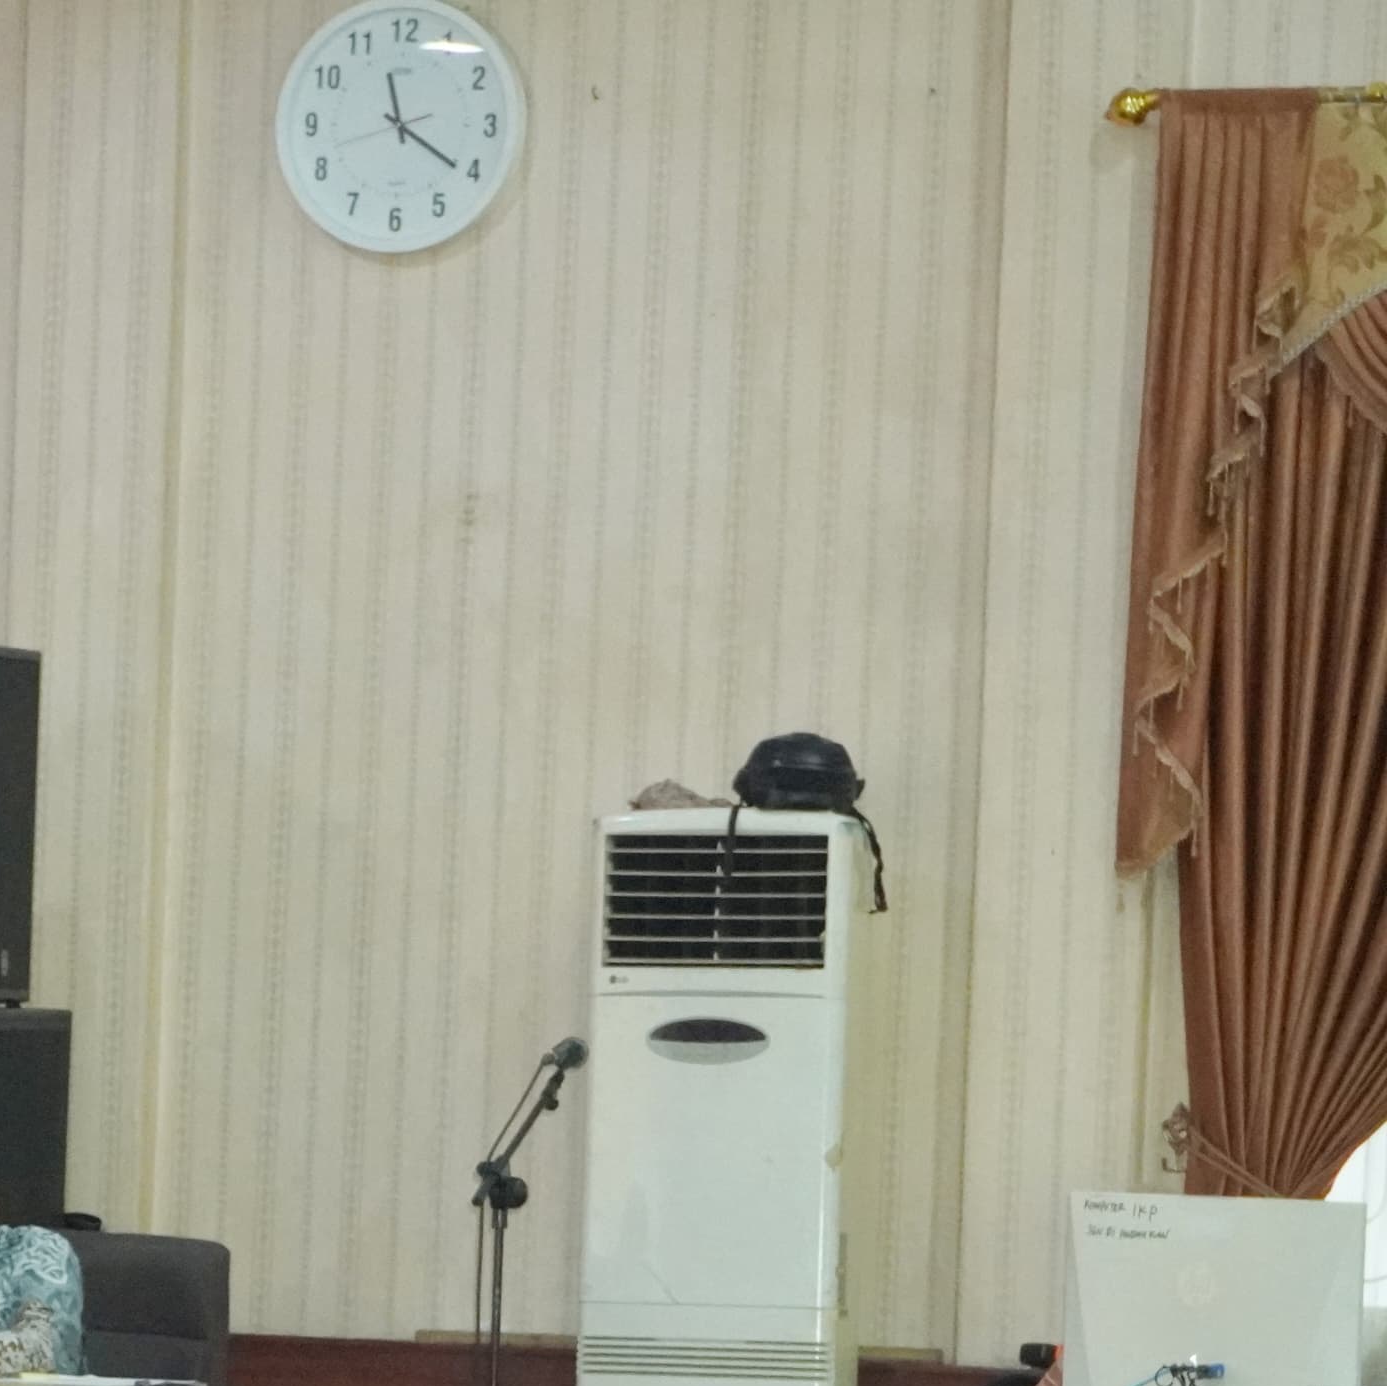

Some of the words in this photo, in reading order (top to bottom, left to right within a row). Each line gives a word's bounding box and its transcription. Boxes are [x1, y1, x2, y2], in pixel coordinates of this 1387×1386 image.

[391, 18, 419, 43] 12
[347, 31, 373, 56] 11
[314, 64, 341, 90] 10
[471, 65, 487, 91] 2
[304, 111, 319, 137] 9
[483, 112, 497, 138] 3
[313, 156, 328, 181] 8
[466, 158, 481, 183] 4
[346, 191, 360, 216] 7
[432, 192, 446, 218] 5
[388, 207, 402, 232] 6
